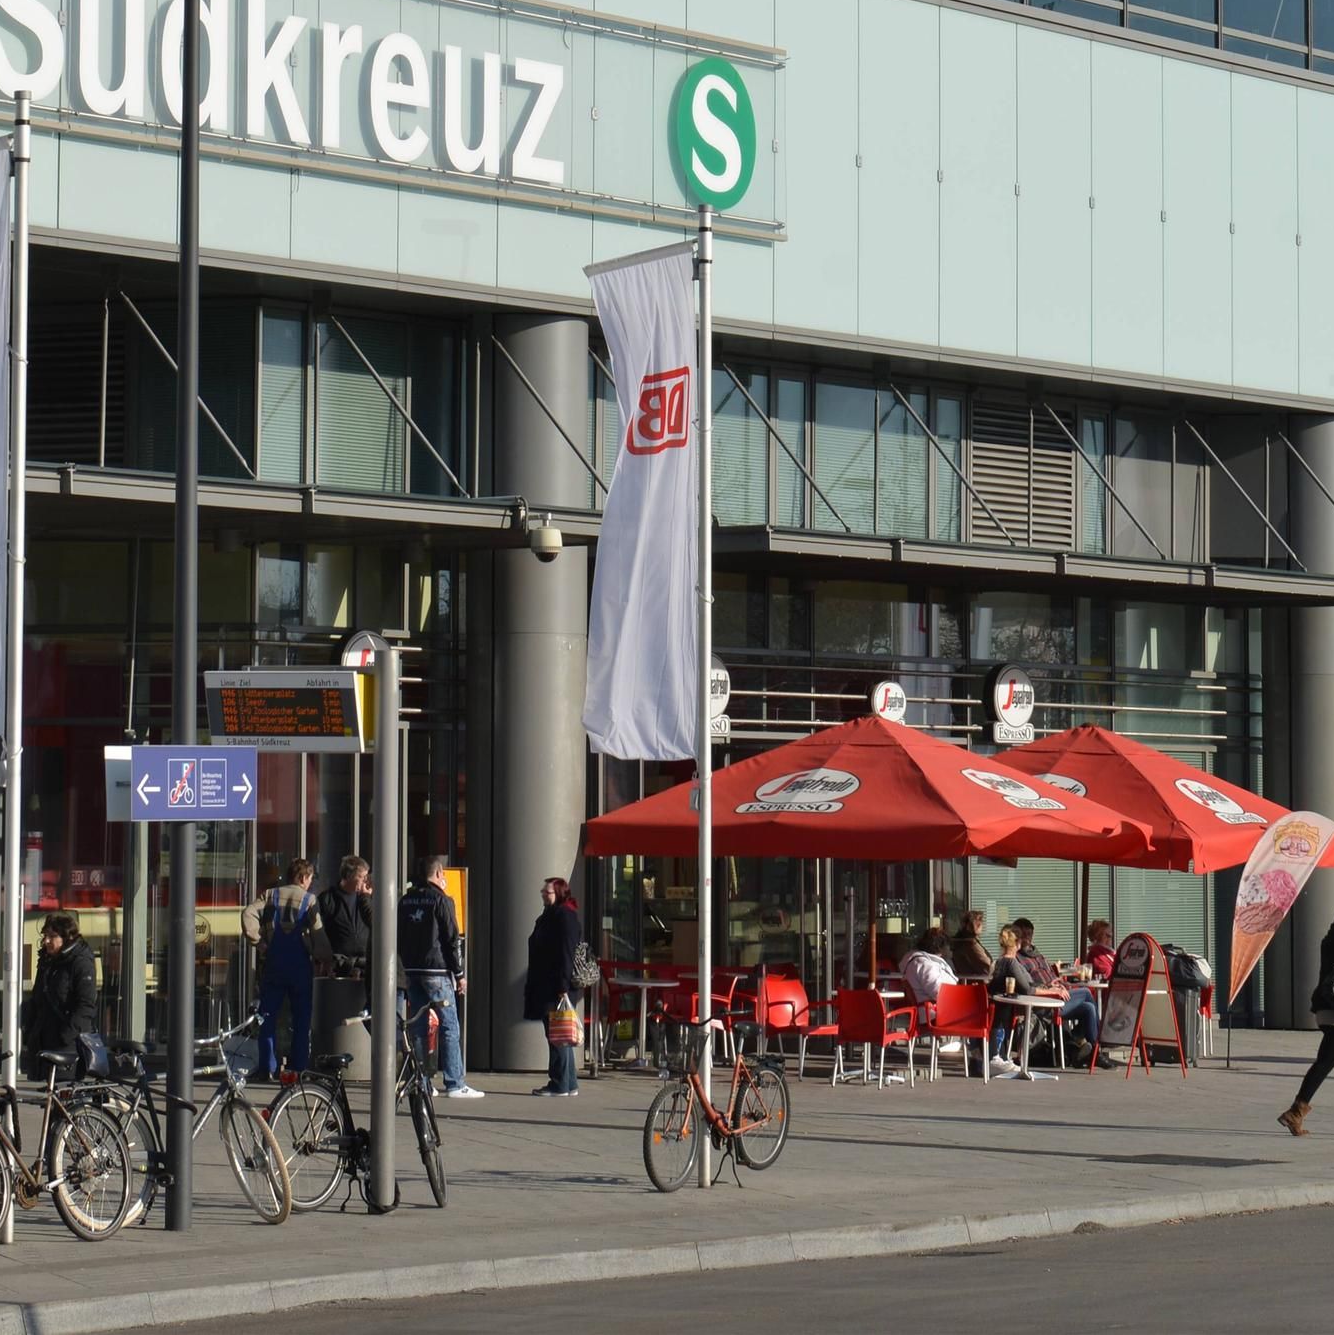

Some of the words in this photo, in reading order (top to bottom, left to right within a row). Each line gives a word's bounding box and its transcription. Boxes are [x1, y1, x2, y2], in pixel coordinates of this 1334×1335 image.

[690, 72, 743, 194] S
[760, 772, 855, 796] Segafredo
[745, 803, 833, 812] ESPRESSO
